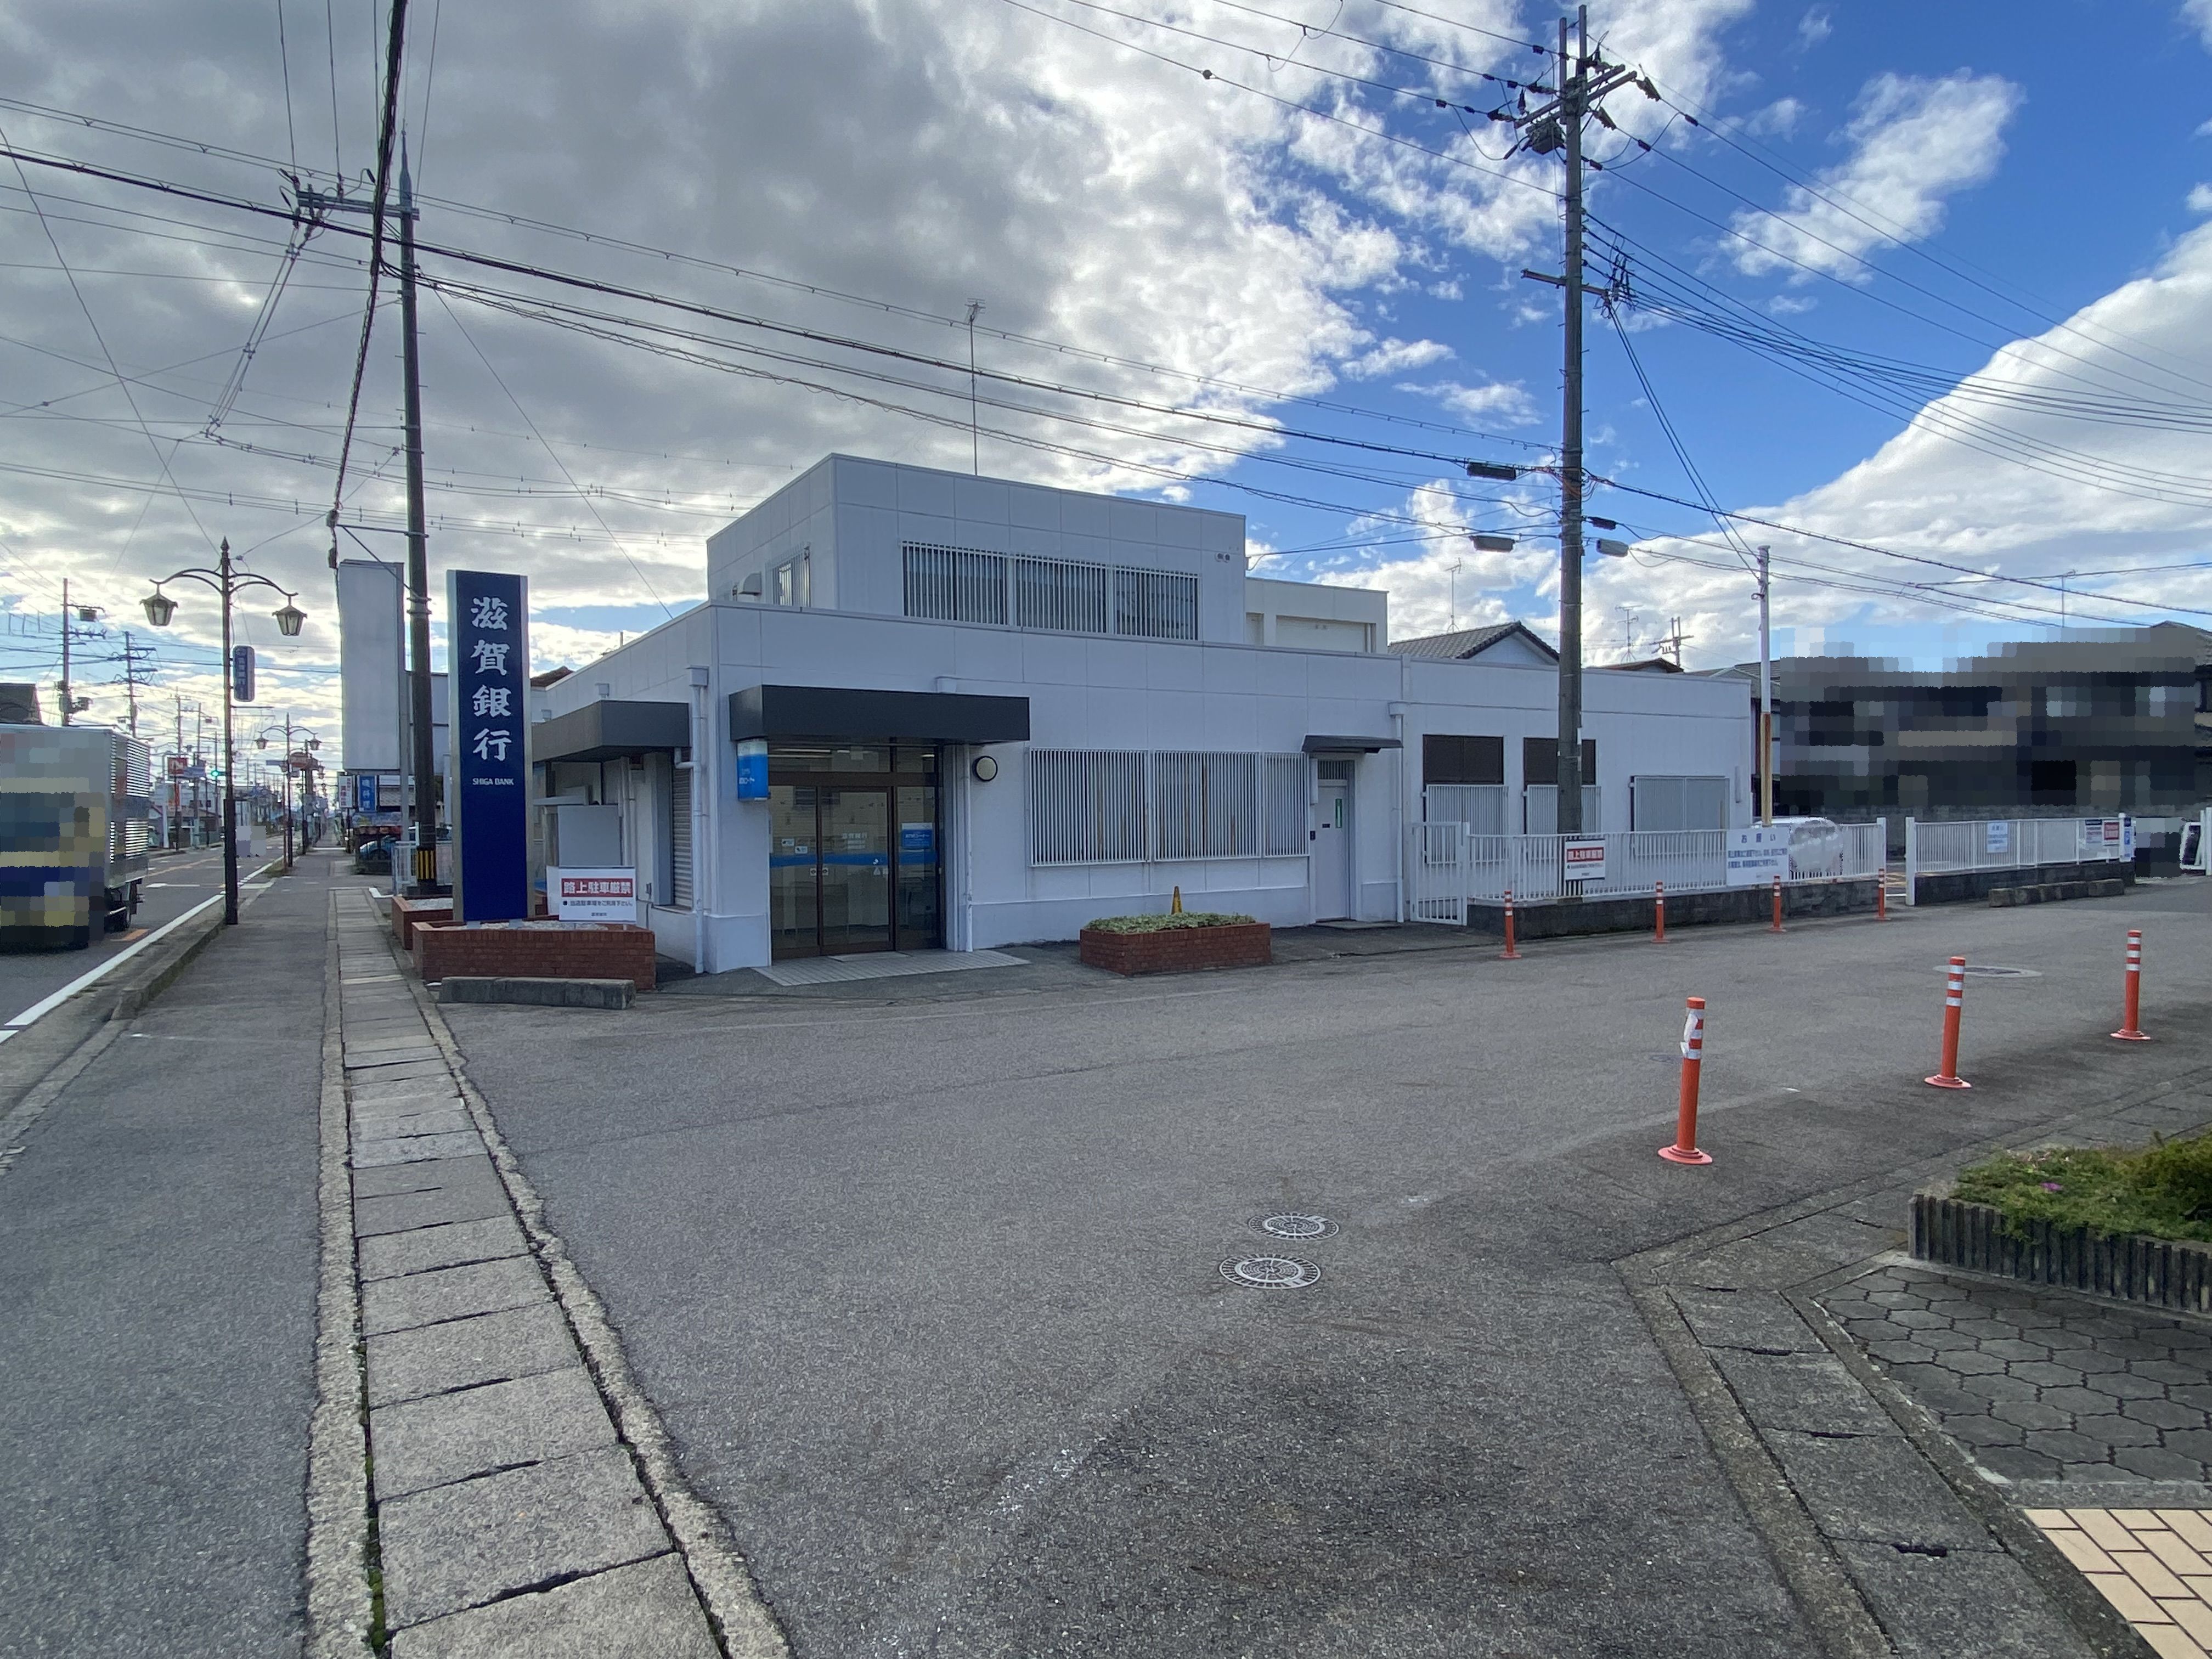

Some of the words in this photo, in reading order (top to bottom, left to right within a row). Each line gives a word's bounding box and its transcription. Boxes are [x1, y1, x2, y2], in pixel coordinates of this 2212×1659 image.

[470, 596, 512, 761] 滋賀銀行
[472, 777, 493, 786] SHIGA
[494, 777, 514, 786] BANK
